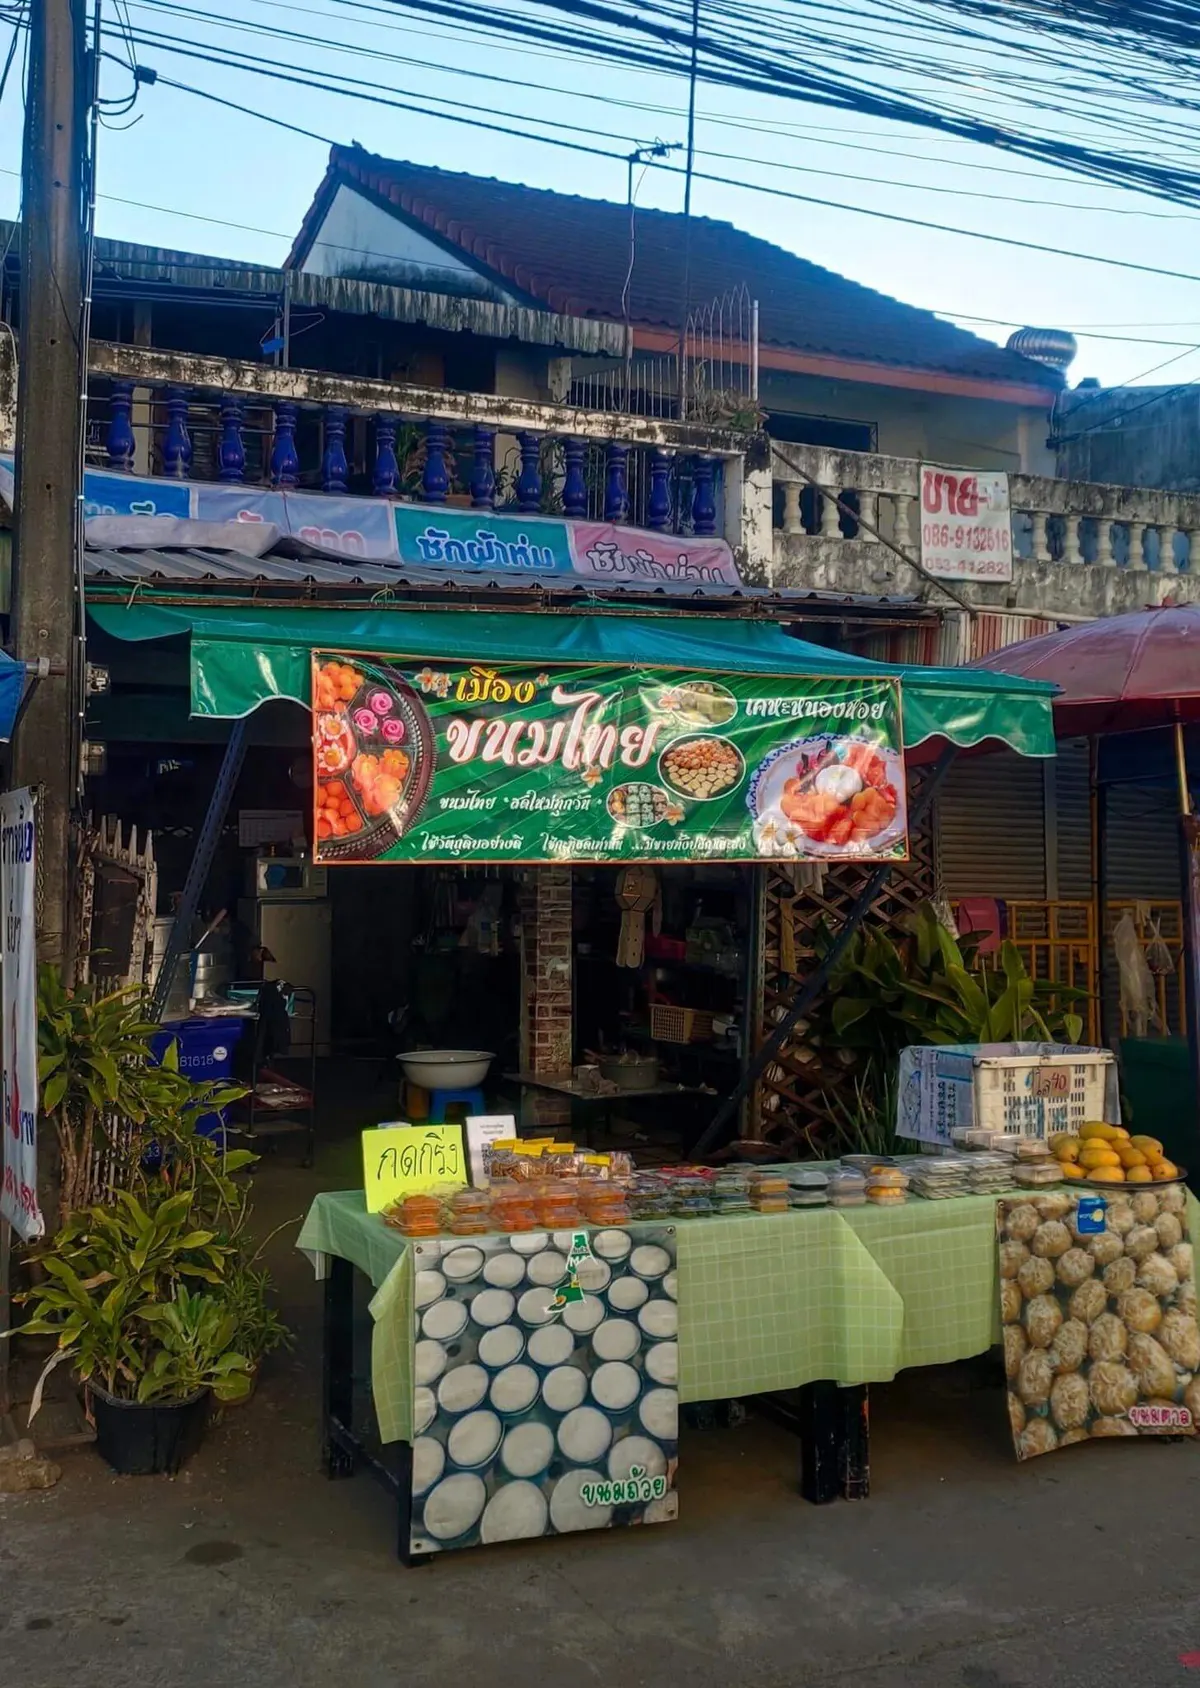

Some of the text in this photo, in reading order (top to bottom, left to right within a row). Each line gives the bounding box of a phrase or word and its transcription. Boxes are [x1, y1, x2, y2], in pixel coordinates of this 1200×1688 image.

[455, 666, 537, 704] เมือง
[446, 685, 665, 770] ขนมไทย
[440, 788, 592, 817] ขนมไทย สดใหม่ทุกวัน
[377, 1127, 458, 1181] กดกริ่ง
[580, 1465, 667, 1507] ขนมถ้วย
